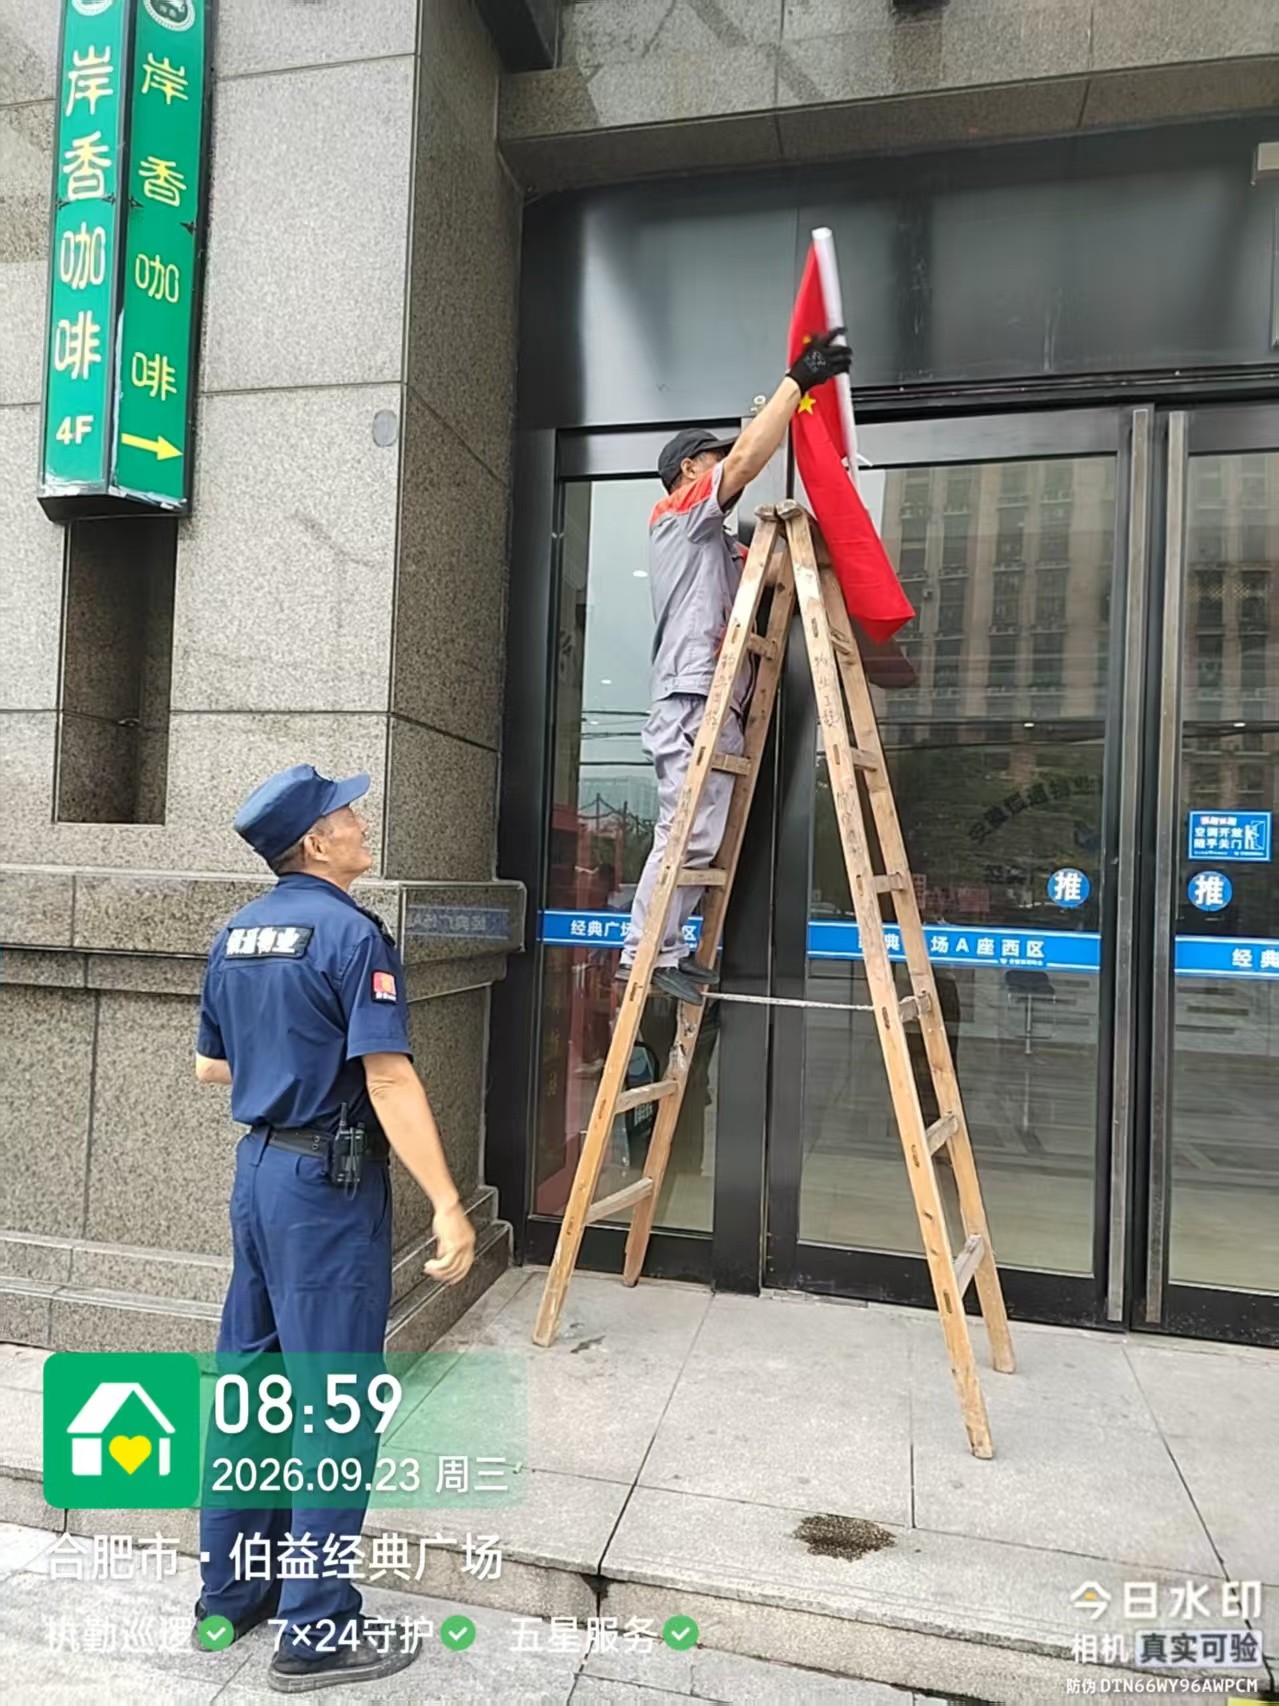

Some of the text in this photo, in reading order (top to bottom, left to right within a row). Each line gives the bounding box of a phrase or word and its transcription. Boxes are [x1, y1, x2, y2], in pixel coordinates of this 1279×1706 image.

[55, 44, 114, 380] 岸香咖啡
[131, 52, 189, 401] 岸香咖啡
[56, 415, 94, 445] 4F
[1054, 871, 1082, 901] 推
[1194, 875, 1224, 905] 推
[858, 933, 1045, 958] 典场A座西区
